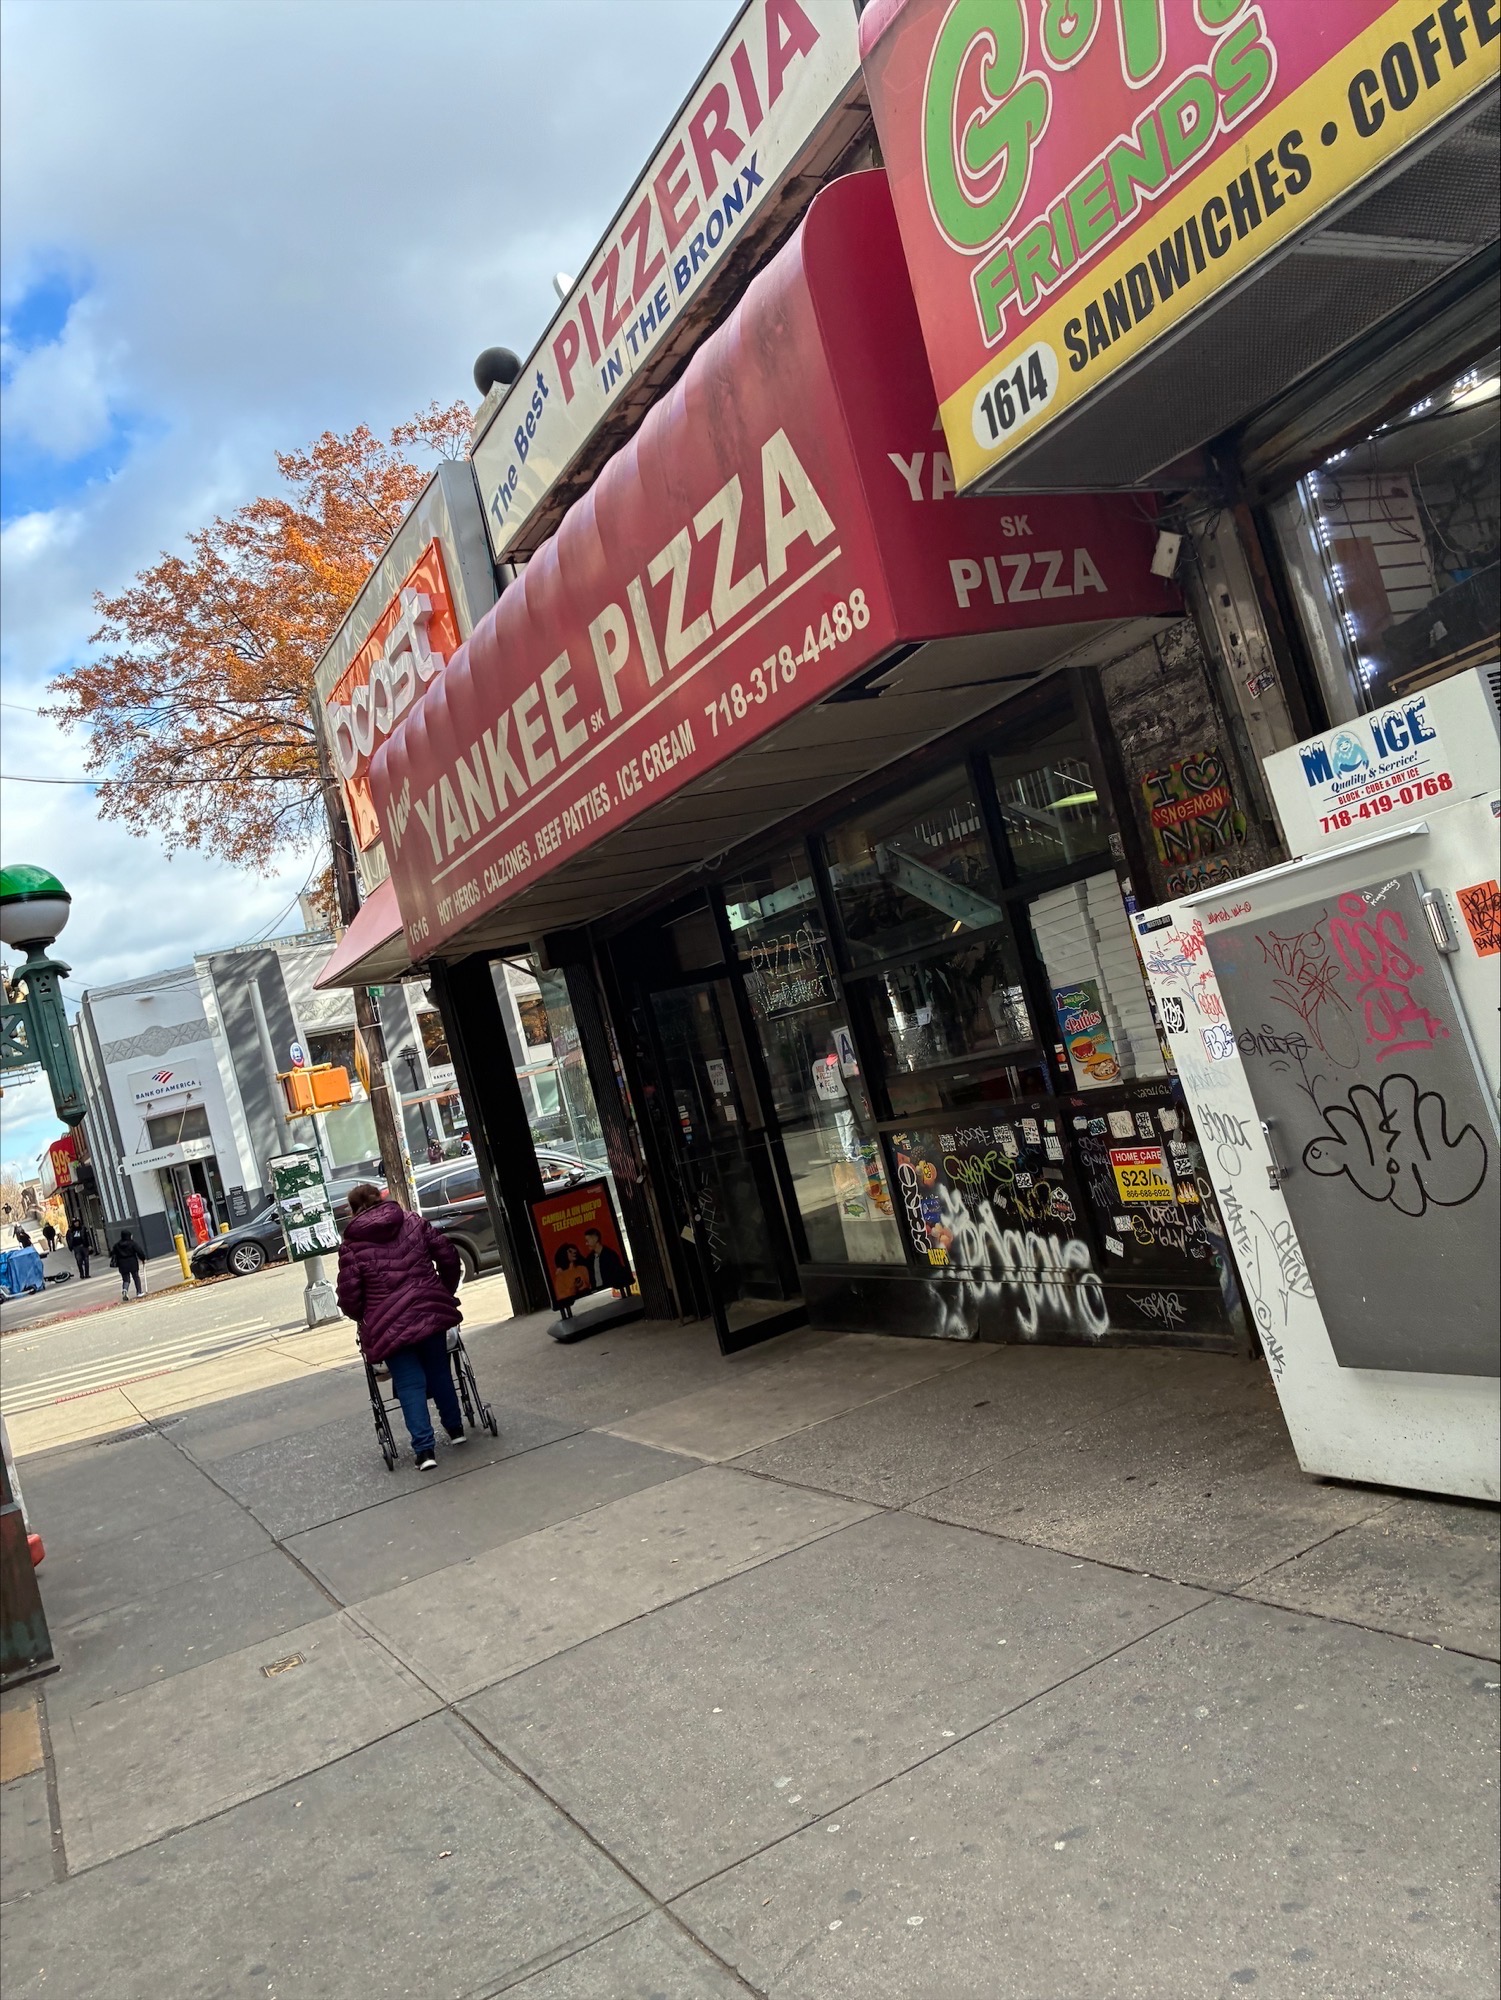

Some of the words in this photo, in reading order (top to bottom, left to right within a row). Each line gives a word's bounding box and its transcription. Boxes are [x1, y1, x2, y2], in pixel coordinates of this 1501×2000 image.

[552, 0, 821, 404] PIZZERIA
[971, 9, 1277, 348] FRIENDS
[600, 345, 624, 395] IN
[626, 287, 670, 356] THE
[673, 151, 765, 296] BRONX
[981, 350, 1048, 440] 1614
[1063, 130, 1312, 372] SANDWICHES
[490, 467, 519, 528] The
[514, 369, 550, 465] Best
[1000, 515, 1033, 537] SK
[588, 427, 837, 720] PIZZA
[948, 547, 1108, 608] PIZZA
[590, 708, 605, 733] SK
[1369, 695, 1437, 759] ICE
[409, 917, 430, 946] 1616
[436, 893, 453, 926] HOT
[453, 878, 481, 919] HEROS
[483, 840, 532, 894] CALZONES
[534, 817, 562, 860] BEEF
[562, 781, 612, 840] PATTIES
[615, 758, 644, 800] ICE
[641, 718, 697, 783] CREAM
[704, 587, 871, 738] 718-378-4488
[414, 649, 590, 866] YANKEE
[1331, 772, 1368, 793] Quality
[1367, 767, 1378, 780] &
[1379, 750, 1419, 775] Service!
[1338, 789, 1361, 805] BLOCK
[1365, 780, 1385, 796] CUBE
[1391, 772, 1406, 787] DRY
[1407, 767, 1421, 780] ICE
[387, 777, 411, 862] New
[1319, 771, 1454, 834] 718-419-0768
[839, 1033, 858, 1064] A
[1065, 1009, 1102, 1035] Patties
[135, 1090, 154, 1100] BANK
[155, 1087, 165, 1095] OF
[165, 1080, 196, 1092] AMERICA
[149, 1155, 167, 1164] AMERICA
[1115, 1152, 1138, 1162] HOME
[1139, 1149, 1162, 1161] CARE
[580, 1198, 602, 1213] NUEVO
[1126, 1188, 1171, 1198] 866-688-6922
